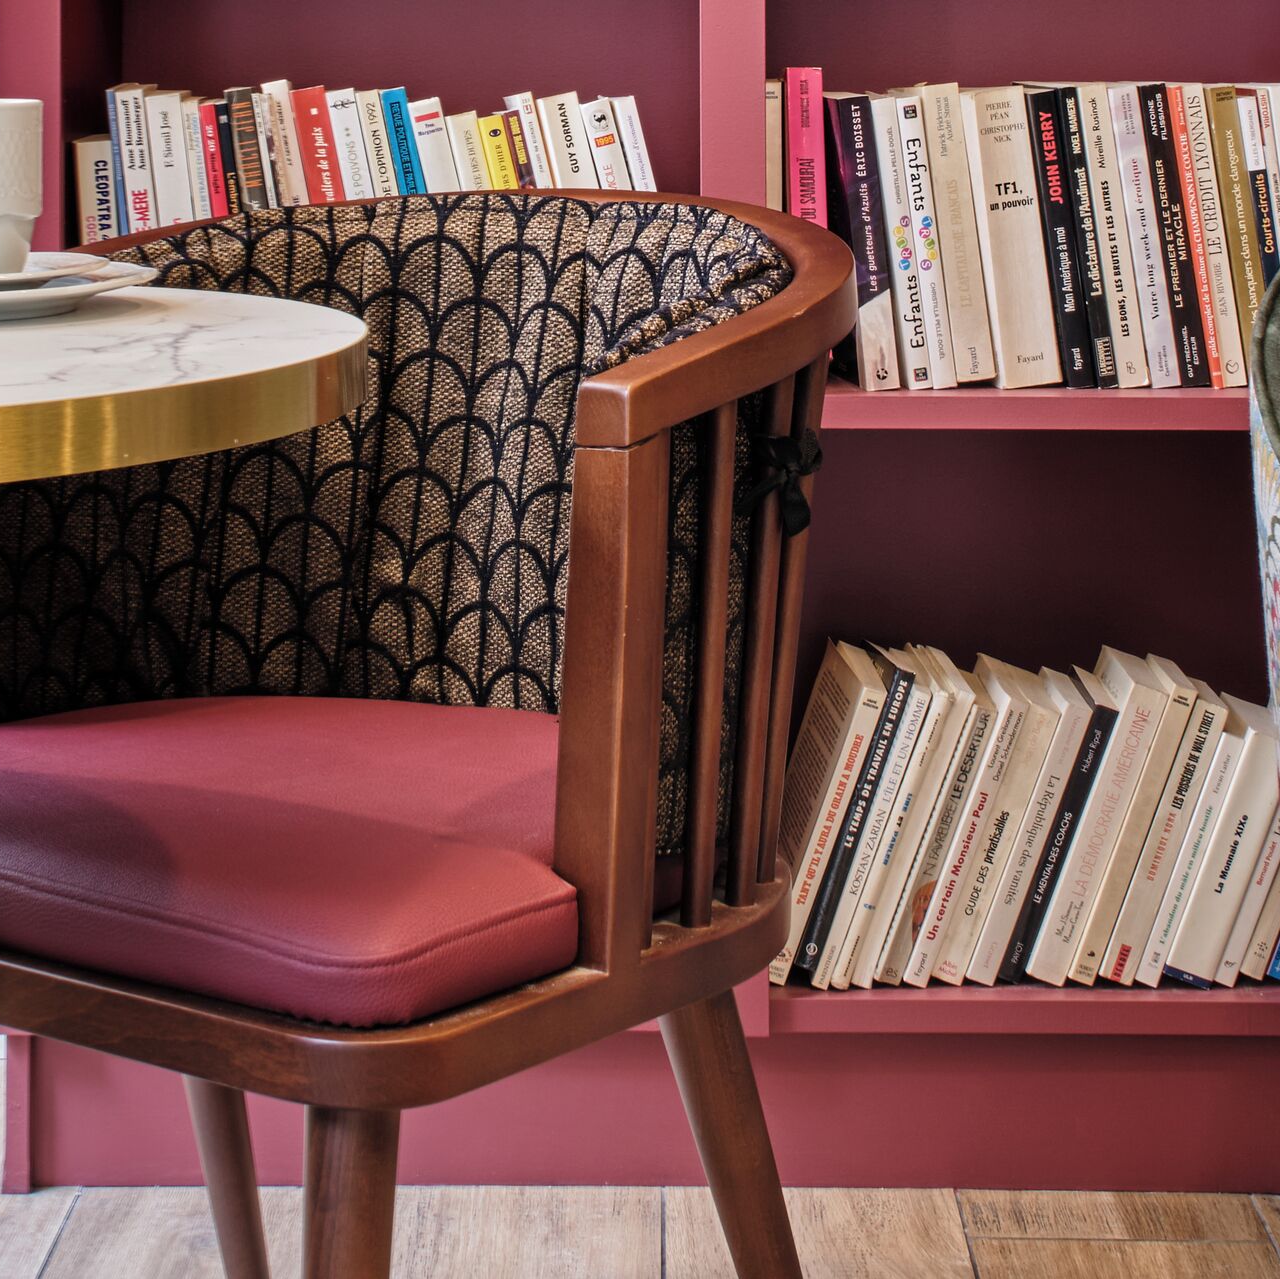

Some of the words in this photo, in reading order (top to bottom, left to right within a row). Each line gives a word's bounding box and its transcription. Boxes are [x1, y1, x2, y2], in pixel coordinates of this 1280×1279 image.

[120, 100, 133, 146] Roumanoff
[133, 97, 144, 146] Bromberger
[557, 102, 574, 149] SORMAN
[850, 104, 864, 149] BOISSET
[1064, 97, 1078, 132] MAMERE
[1038, 112, 1057, 161] KERRY
[1070, 132, 1082, 154] NOEL
[1187, 95, 1210, 171] LYONNAIS
[127, 149, 136, 170] Anne
[138, 149, 146, 170] Anne
[567, 152, 580, 173] GUY
[855, 151, 867, 177] ÉRIC
[1046, 164, 1063, 204] JOHN
[1073, 167, 1093, 217] l'Audimat
[858, 183, 871, 222] d'Azulis
[1197, 176, 1218, 232] CREDIT
[1255, 173, 1274, 253] Courts-circuits
[1054, 226, 1066, 243] moi
[1080, 215, 1095, 234] de
[864, 224, 877, 271] guetteurs
[1056, 243, 1067, 251] à
[1082, 231, 1100, 281] dictature
[1206, 236, 1222, 255] LE
[869, 274, 878, 291] Les
[1059, 251, 1073, 292] Amérique
[1090, 281, 1102, 296] La
[903, 274, 925, 349] Enfants
[1063, 292, 1076, 312] Mon
[887, 679, 908, 720] EUROPE
[882, 721, 893, 737] EN
[866, 737, 887, 780] TRAVAIL
[861, 783, 872, 798] DE
[849, 799, 867, 835] TEMPS
[1054, 811, 1072, 846] COACHS
[843, 834, 854, 848] LE
[1047, 846, 1060, 863] DES
[1214, 881, 1224, 894] La
[1219, 839, 1239, 880] Monnaie
[1234, 814, 1248, 838] XIXe
[926, 924, 939, 941] Un
[936, 879, 956, 922] certain
[950, 820, 977, 876] Monsieur
[972, 791, 989, 818] Paul
[964, 885, 982, 916] GUIDE
[975, 865, 989, 884] DES
[983, 810, 1010, 865] privatisables
[1036, 863, 1054, 894] MENTAL
[1032, 893, 1042, 904] LE
